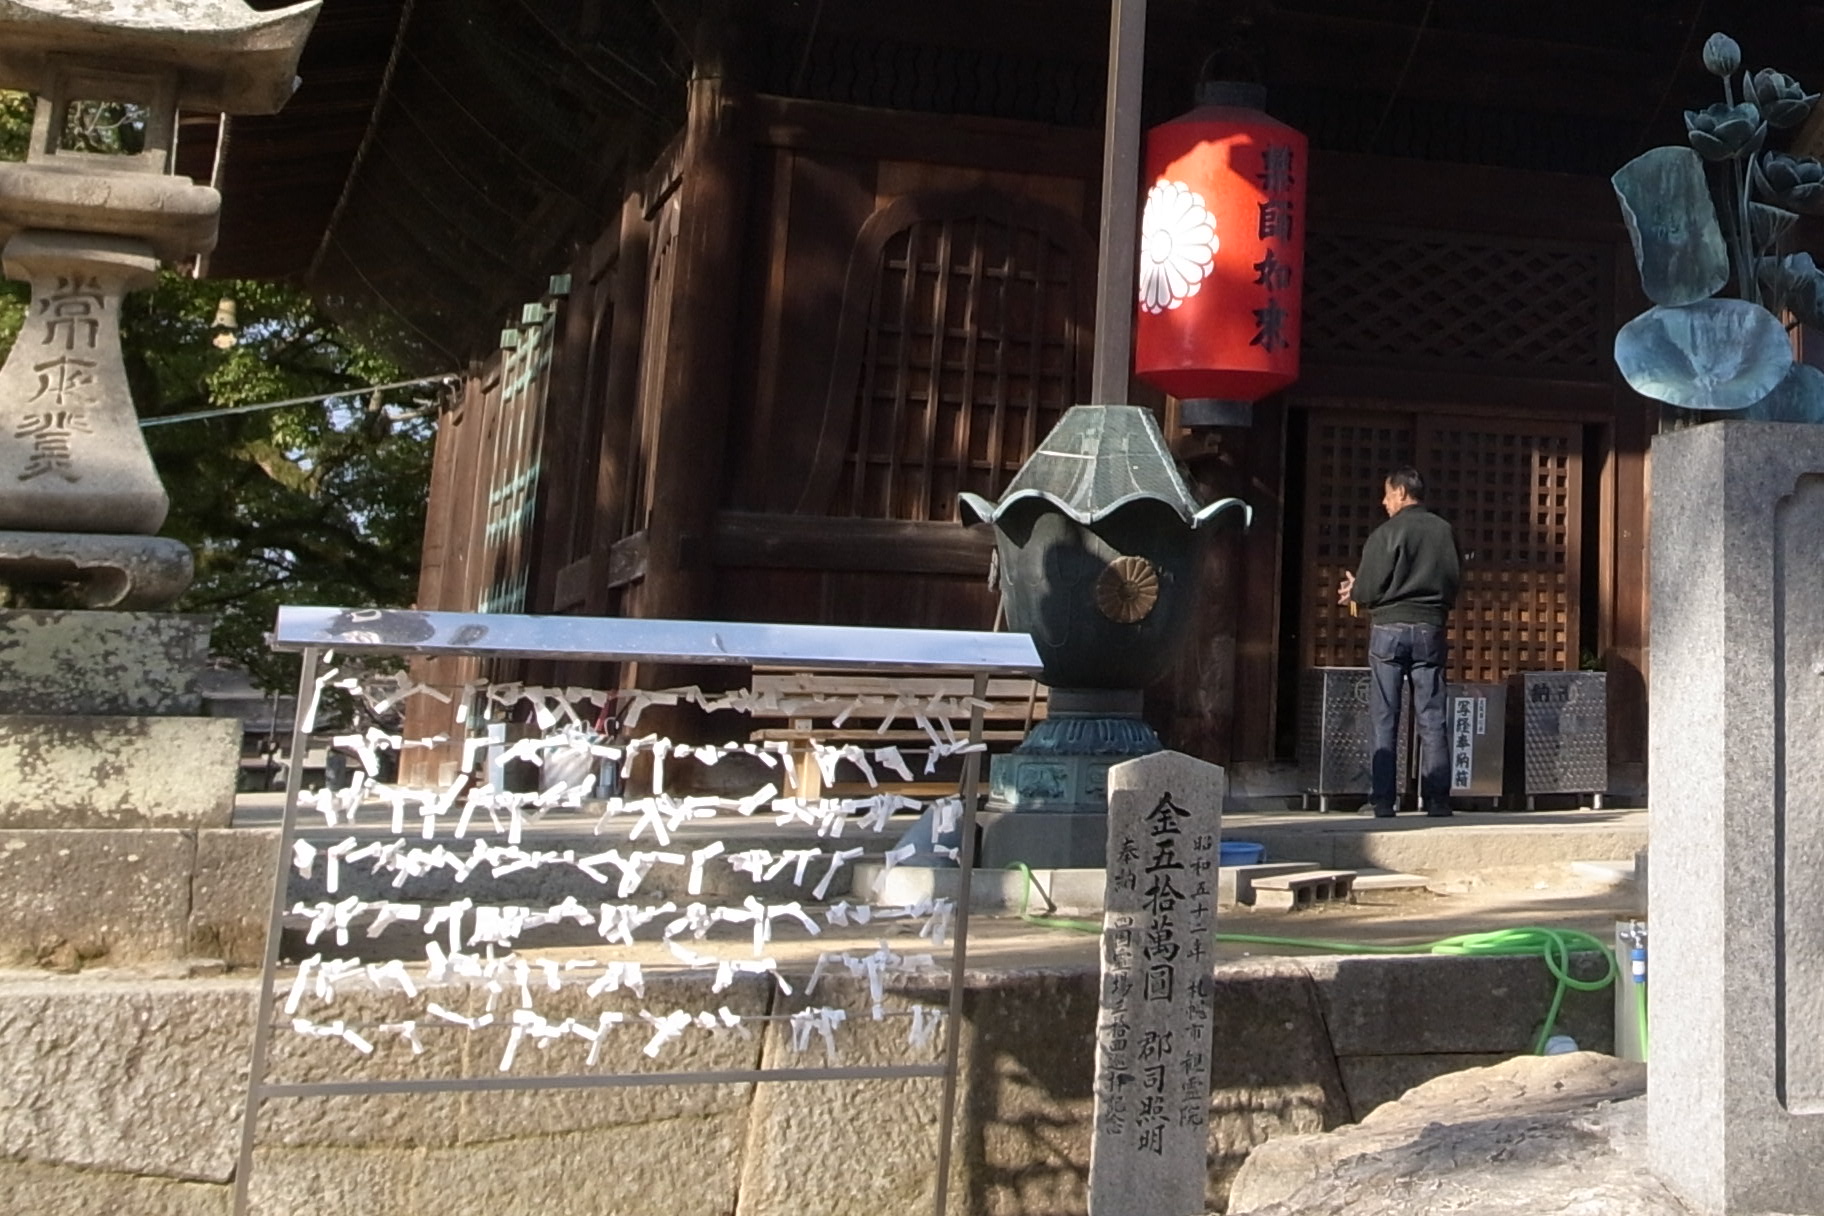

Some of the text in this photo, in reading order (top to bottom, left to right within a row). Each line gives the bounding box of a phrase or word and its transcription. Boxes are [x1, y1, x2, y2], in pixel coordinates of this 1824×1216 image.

[1113, 837, 1141, 893] 奉納
[1186, 835, 1213, 965] 昭和五十二年
